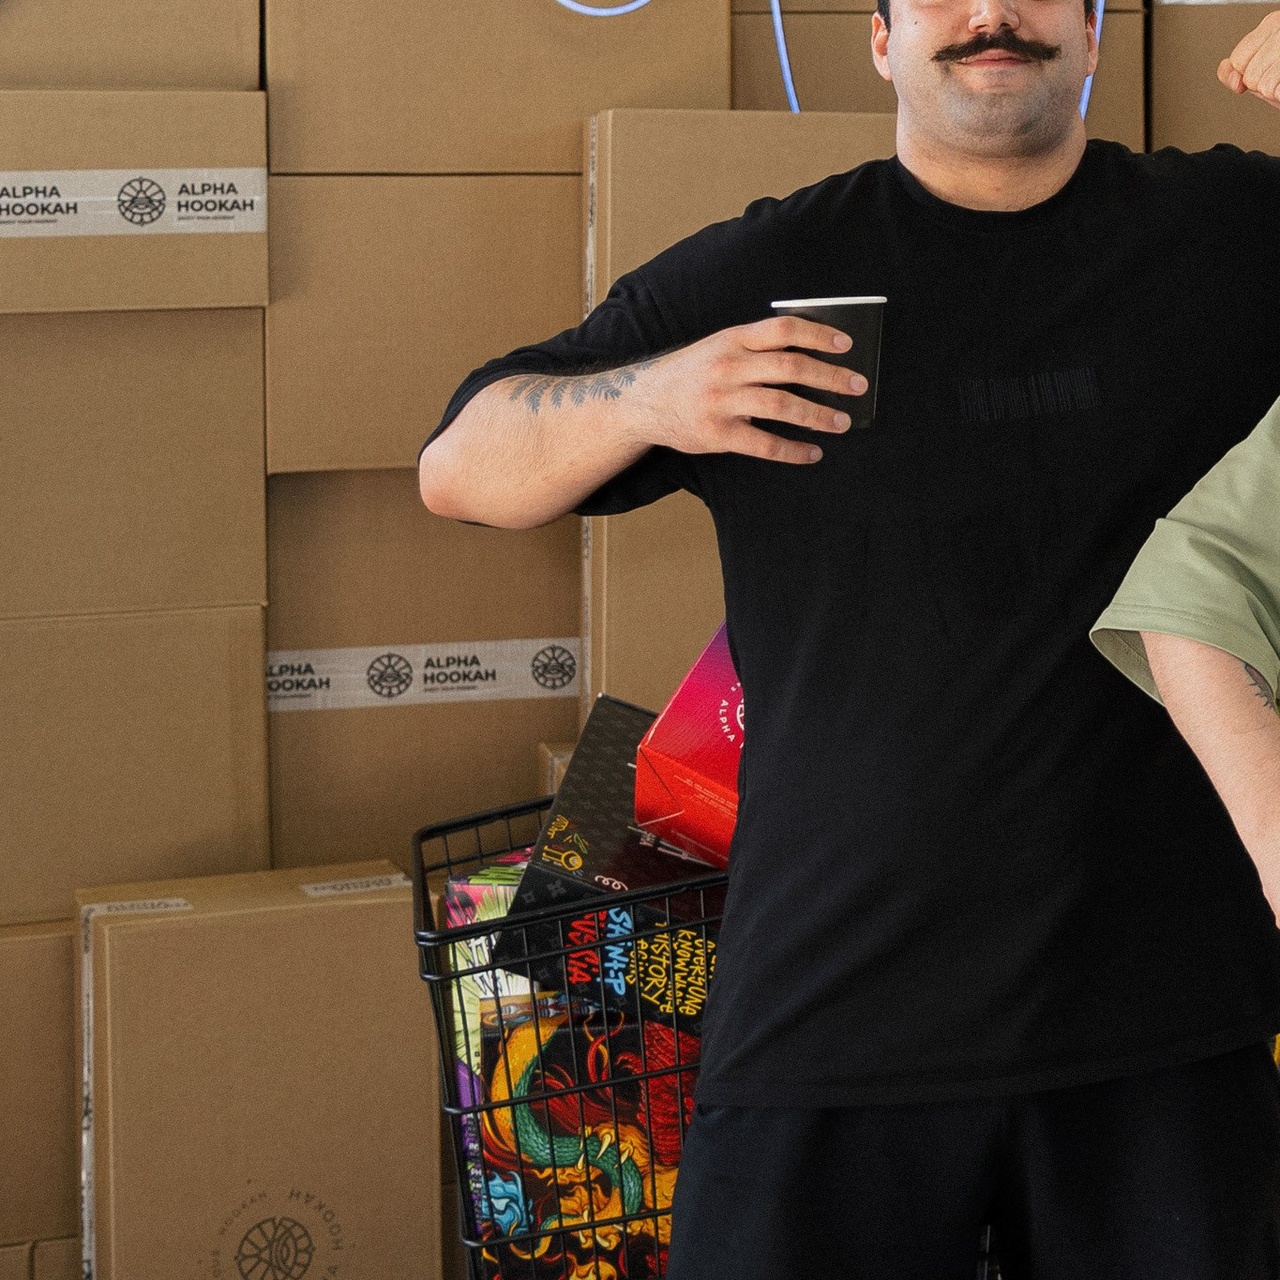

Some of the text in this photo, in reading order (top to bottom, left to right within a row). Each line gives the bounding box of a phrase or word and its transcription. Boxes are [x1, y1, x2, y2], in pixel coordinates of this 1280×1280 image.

[0, 185, 61, 199] ALPHA
[178, 182, 238, 196] ALPHA
[0, 202, 78, 217] HOOKAH
[177, 199, 255, 212] HOOKAH
[425, 654, 482, 669] ALPHA
[267, 663, 315, 677] LPHA
[423, 669, 497, 684] HOOKAH
[267, 677, 331, 693] OOKAH
[718, 698, 736, 743] ALPHA
[288, 1188, 343, 1251] HOOKAH
